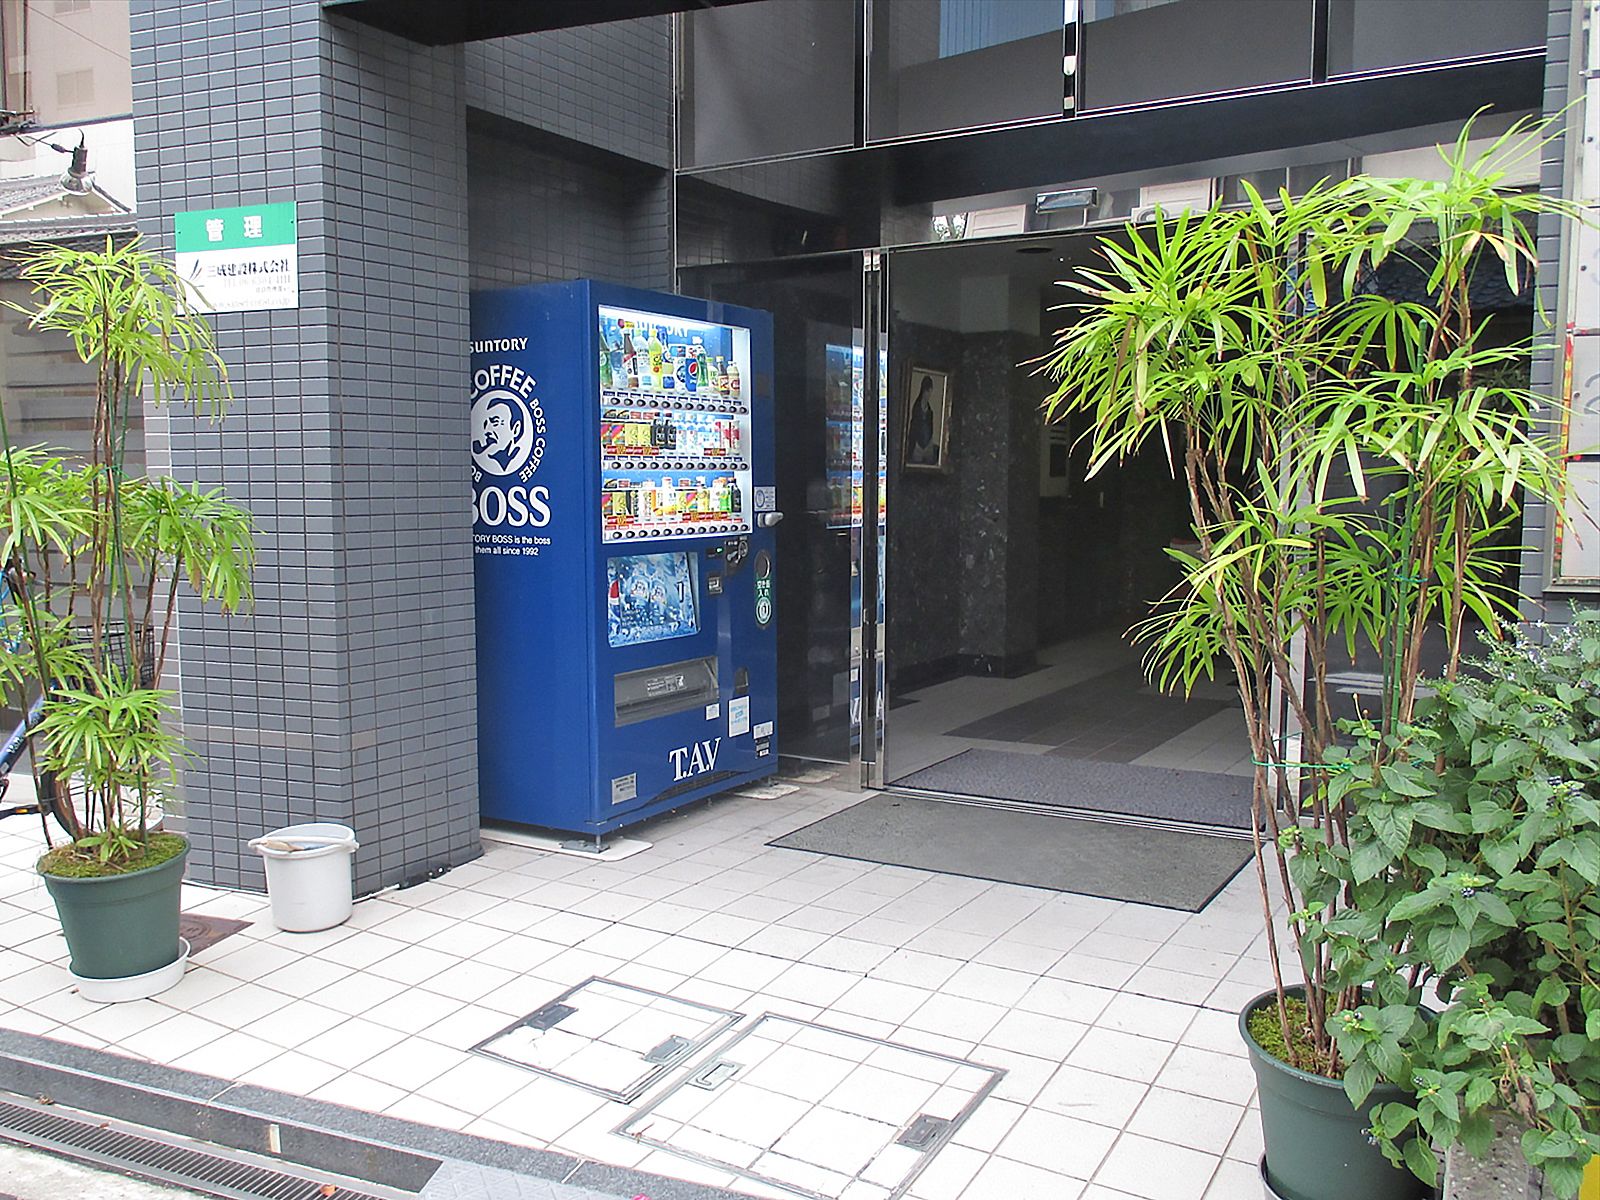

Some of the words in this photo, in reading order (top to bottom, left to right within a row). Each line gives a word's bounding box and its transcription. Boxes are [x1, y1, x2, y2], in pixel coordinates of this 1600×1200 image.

[206, 215, 263, 242] 管理
[529, 398, 547, 434] BOSS
[519, 437, 547, 483] COFFEE
[492, 534, 513, 543] BOSS
[514, 535, 521, 544] is
[522, 535, 533, 545] the
[533, 536, 551, 545] boss
[493, 546, 502, 555] all
[503, 546, 521, 555] since
[522, 547, 539, 556] 1992
